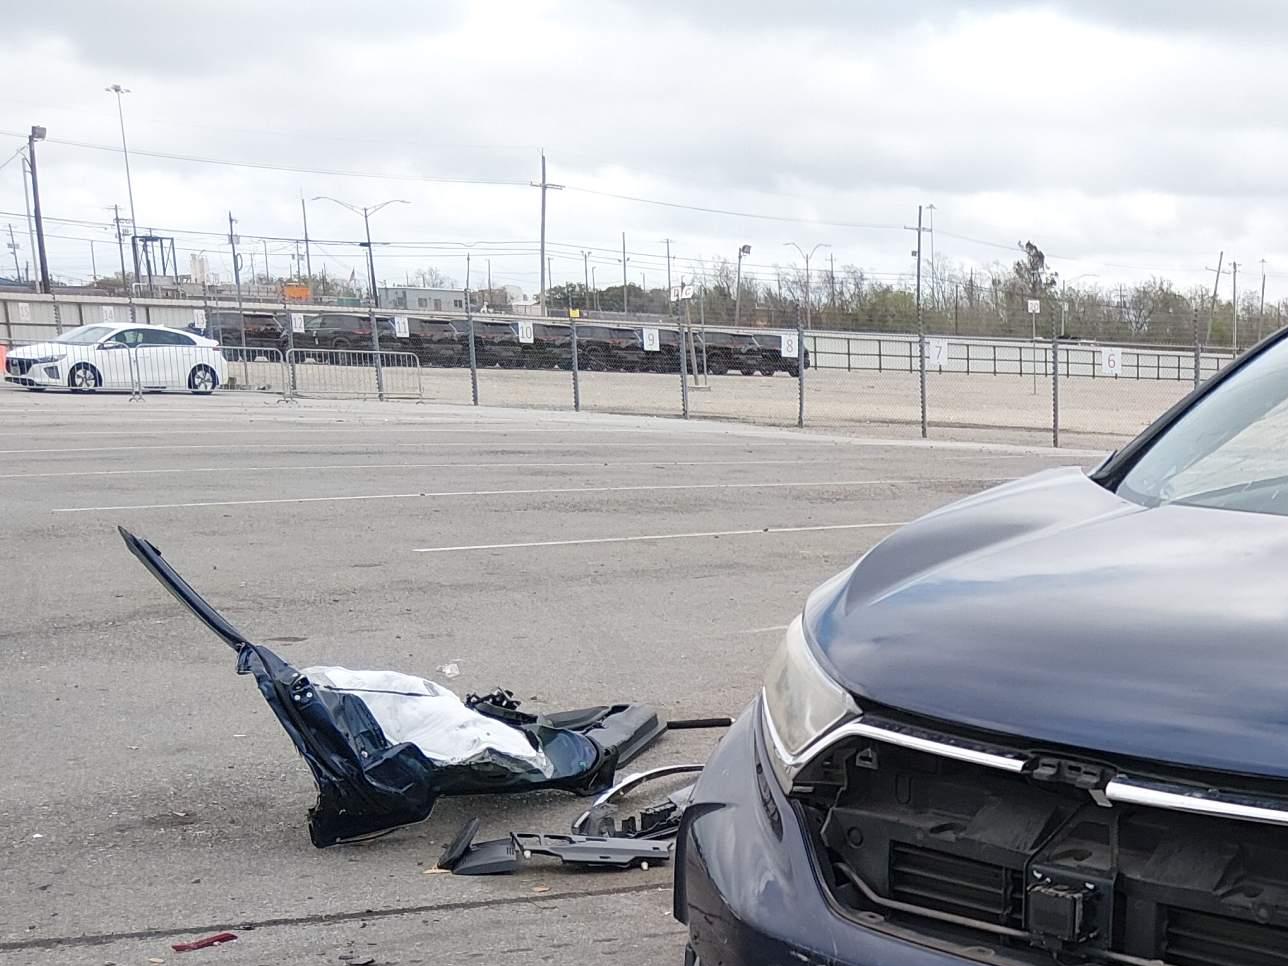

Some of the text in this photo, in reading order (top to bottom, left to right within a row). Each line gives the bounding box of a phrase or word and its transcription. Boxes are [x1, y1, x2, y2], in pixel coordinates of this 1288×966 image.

[293, 317, 303, 330] 12
[397, 318, 408, 334] 11
[520, 327, 532, 340] 10
[647, 332, 655, 346] 9
[786, 338, 794, 353] 8
[935, 346, 943, 360] 7
[1107, 353, 1116, 369] 6
